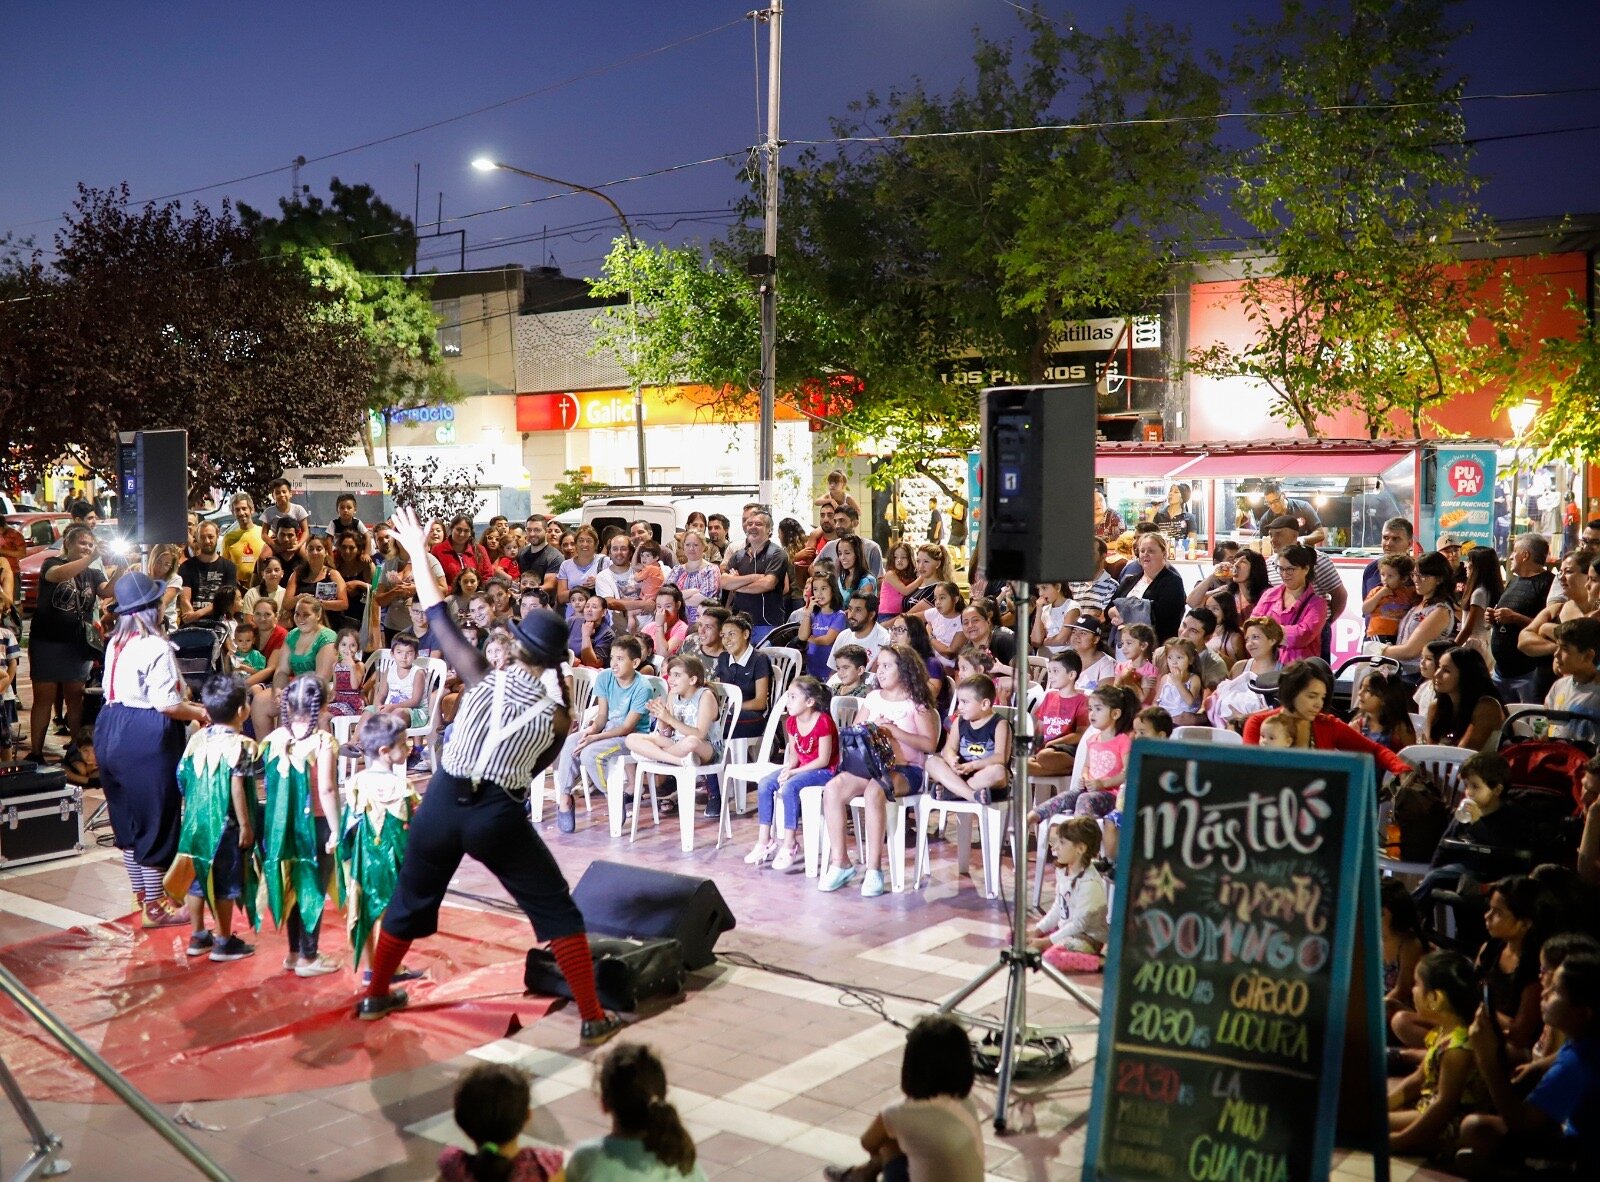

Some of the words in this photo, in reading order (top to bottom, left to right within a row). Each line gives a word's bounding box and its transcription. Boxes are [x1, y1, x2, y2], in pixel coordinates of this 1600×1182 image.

[1455, 466, 1475, 479] PU
[1458, 480, 1477, 493] PA
[1137, 909, 1330, 974] DOMINGO
